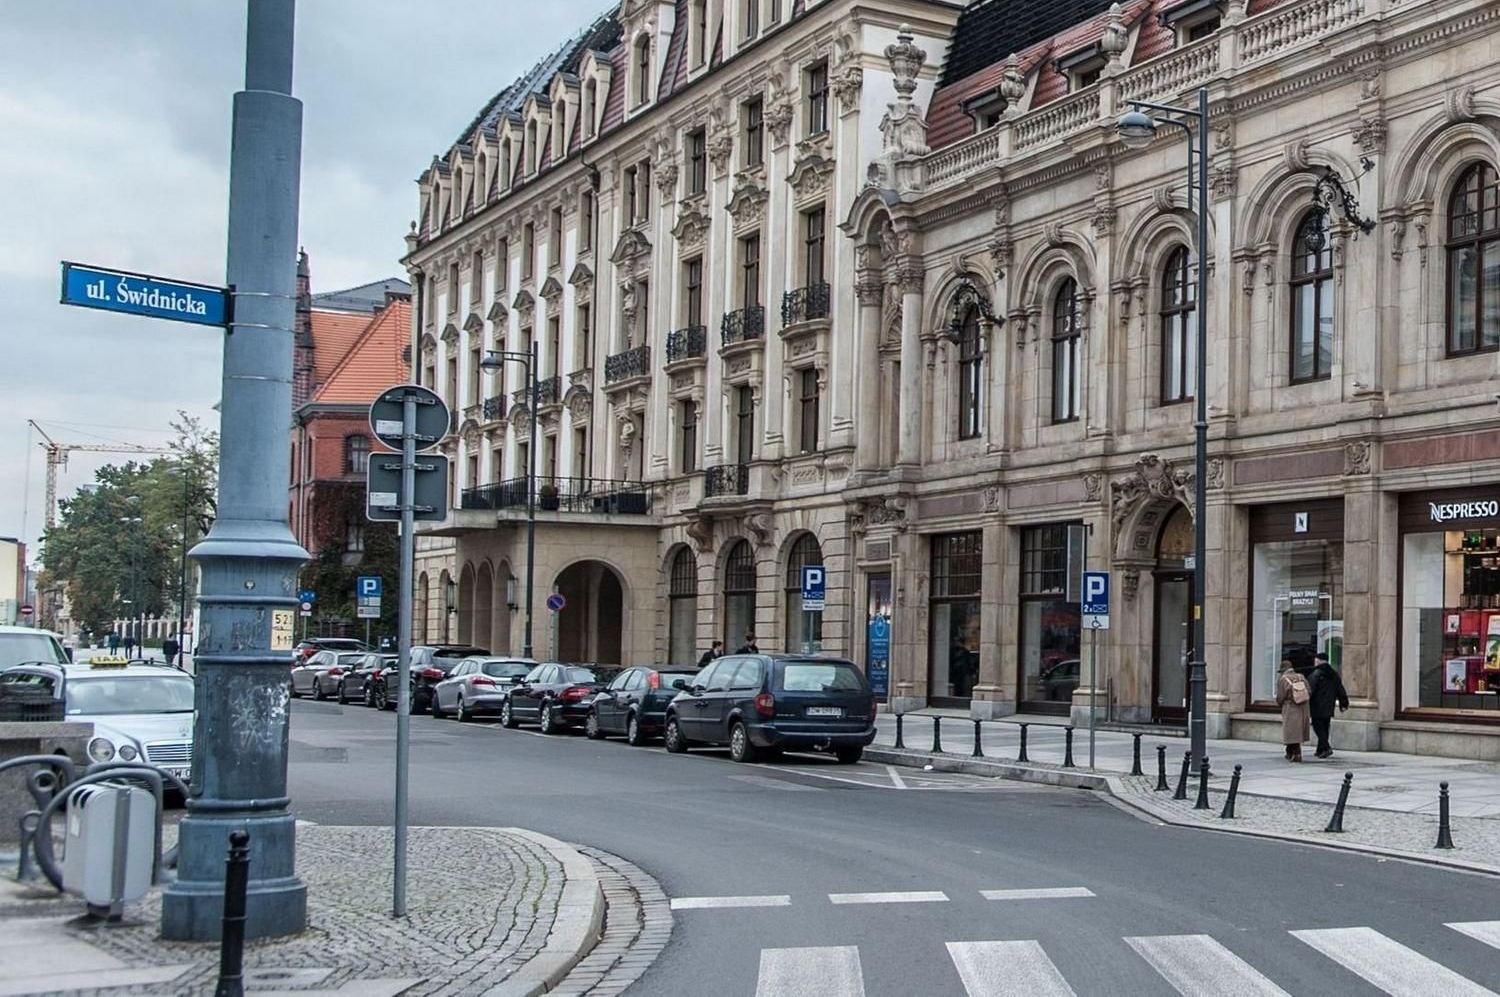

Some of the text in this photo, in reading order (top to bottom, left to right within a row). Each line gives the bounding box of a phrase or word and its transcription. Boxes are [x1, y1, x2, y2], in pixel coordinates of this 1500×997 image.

[86, 277, 206, 315] ul. Świdnicka
[1429, 501, 1498, 522] NESPRESSO
[363, 579, 377, 594] P
[806, 569, 822, 590] P
[1087, 576, 1105, 602] P
